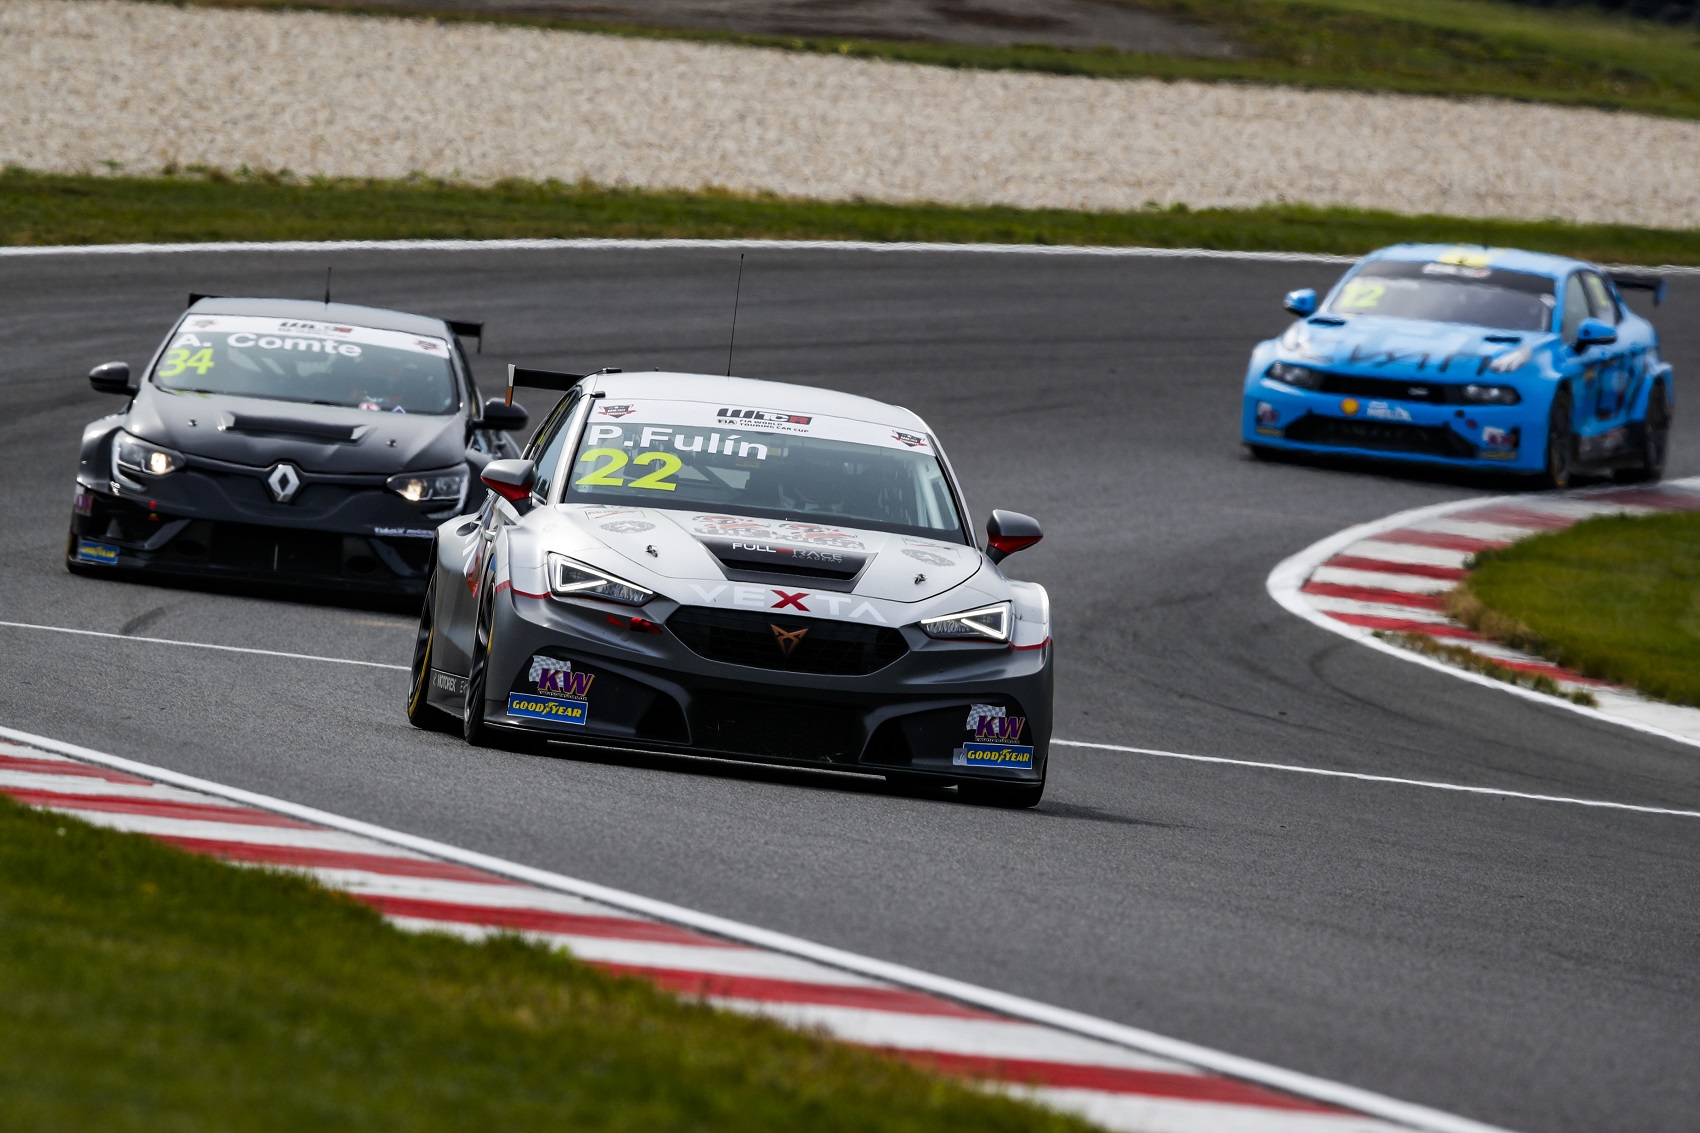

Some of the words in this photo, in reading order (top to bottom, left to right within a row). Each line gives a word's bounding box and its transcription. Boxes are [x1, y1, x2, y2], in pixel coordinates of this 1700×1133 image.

[1341, 284, 1386, 307] 12
[172, 334, 211, 349] A.
[227, 333, 362, 358] Comte
[158, 348, 214, 377] 34
[575, 448, 682, 491] 22
[688, 584, 888, 624] VEXTA
[538, 667, 595, 697] KW
[975, 714, 1026, 740] KW
